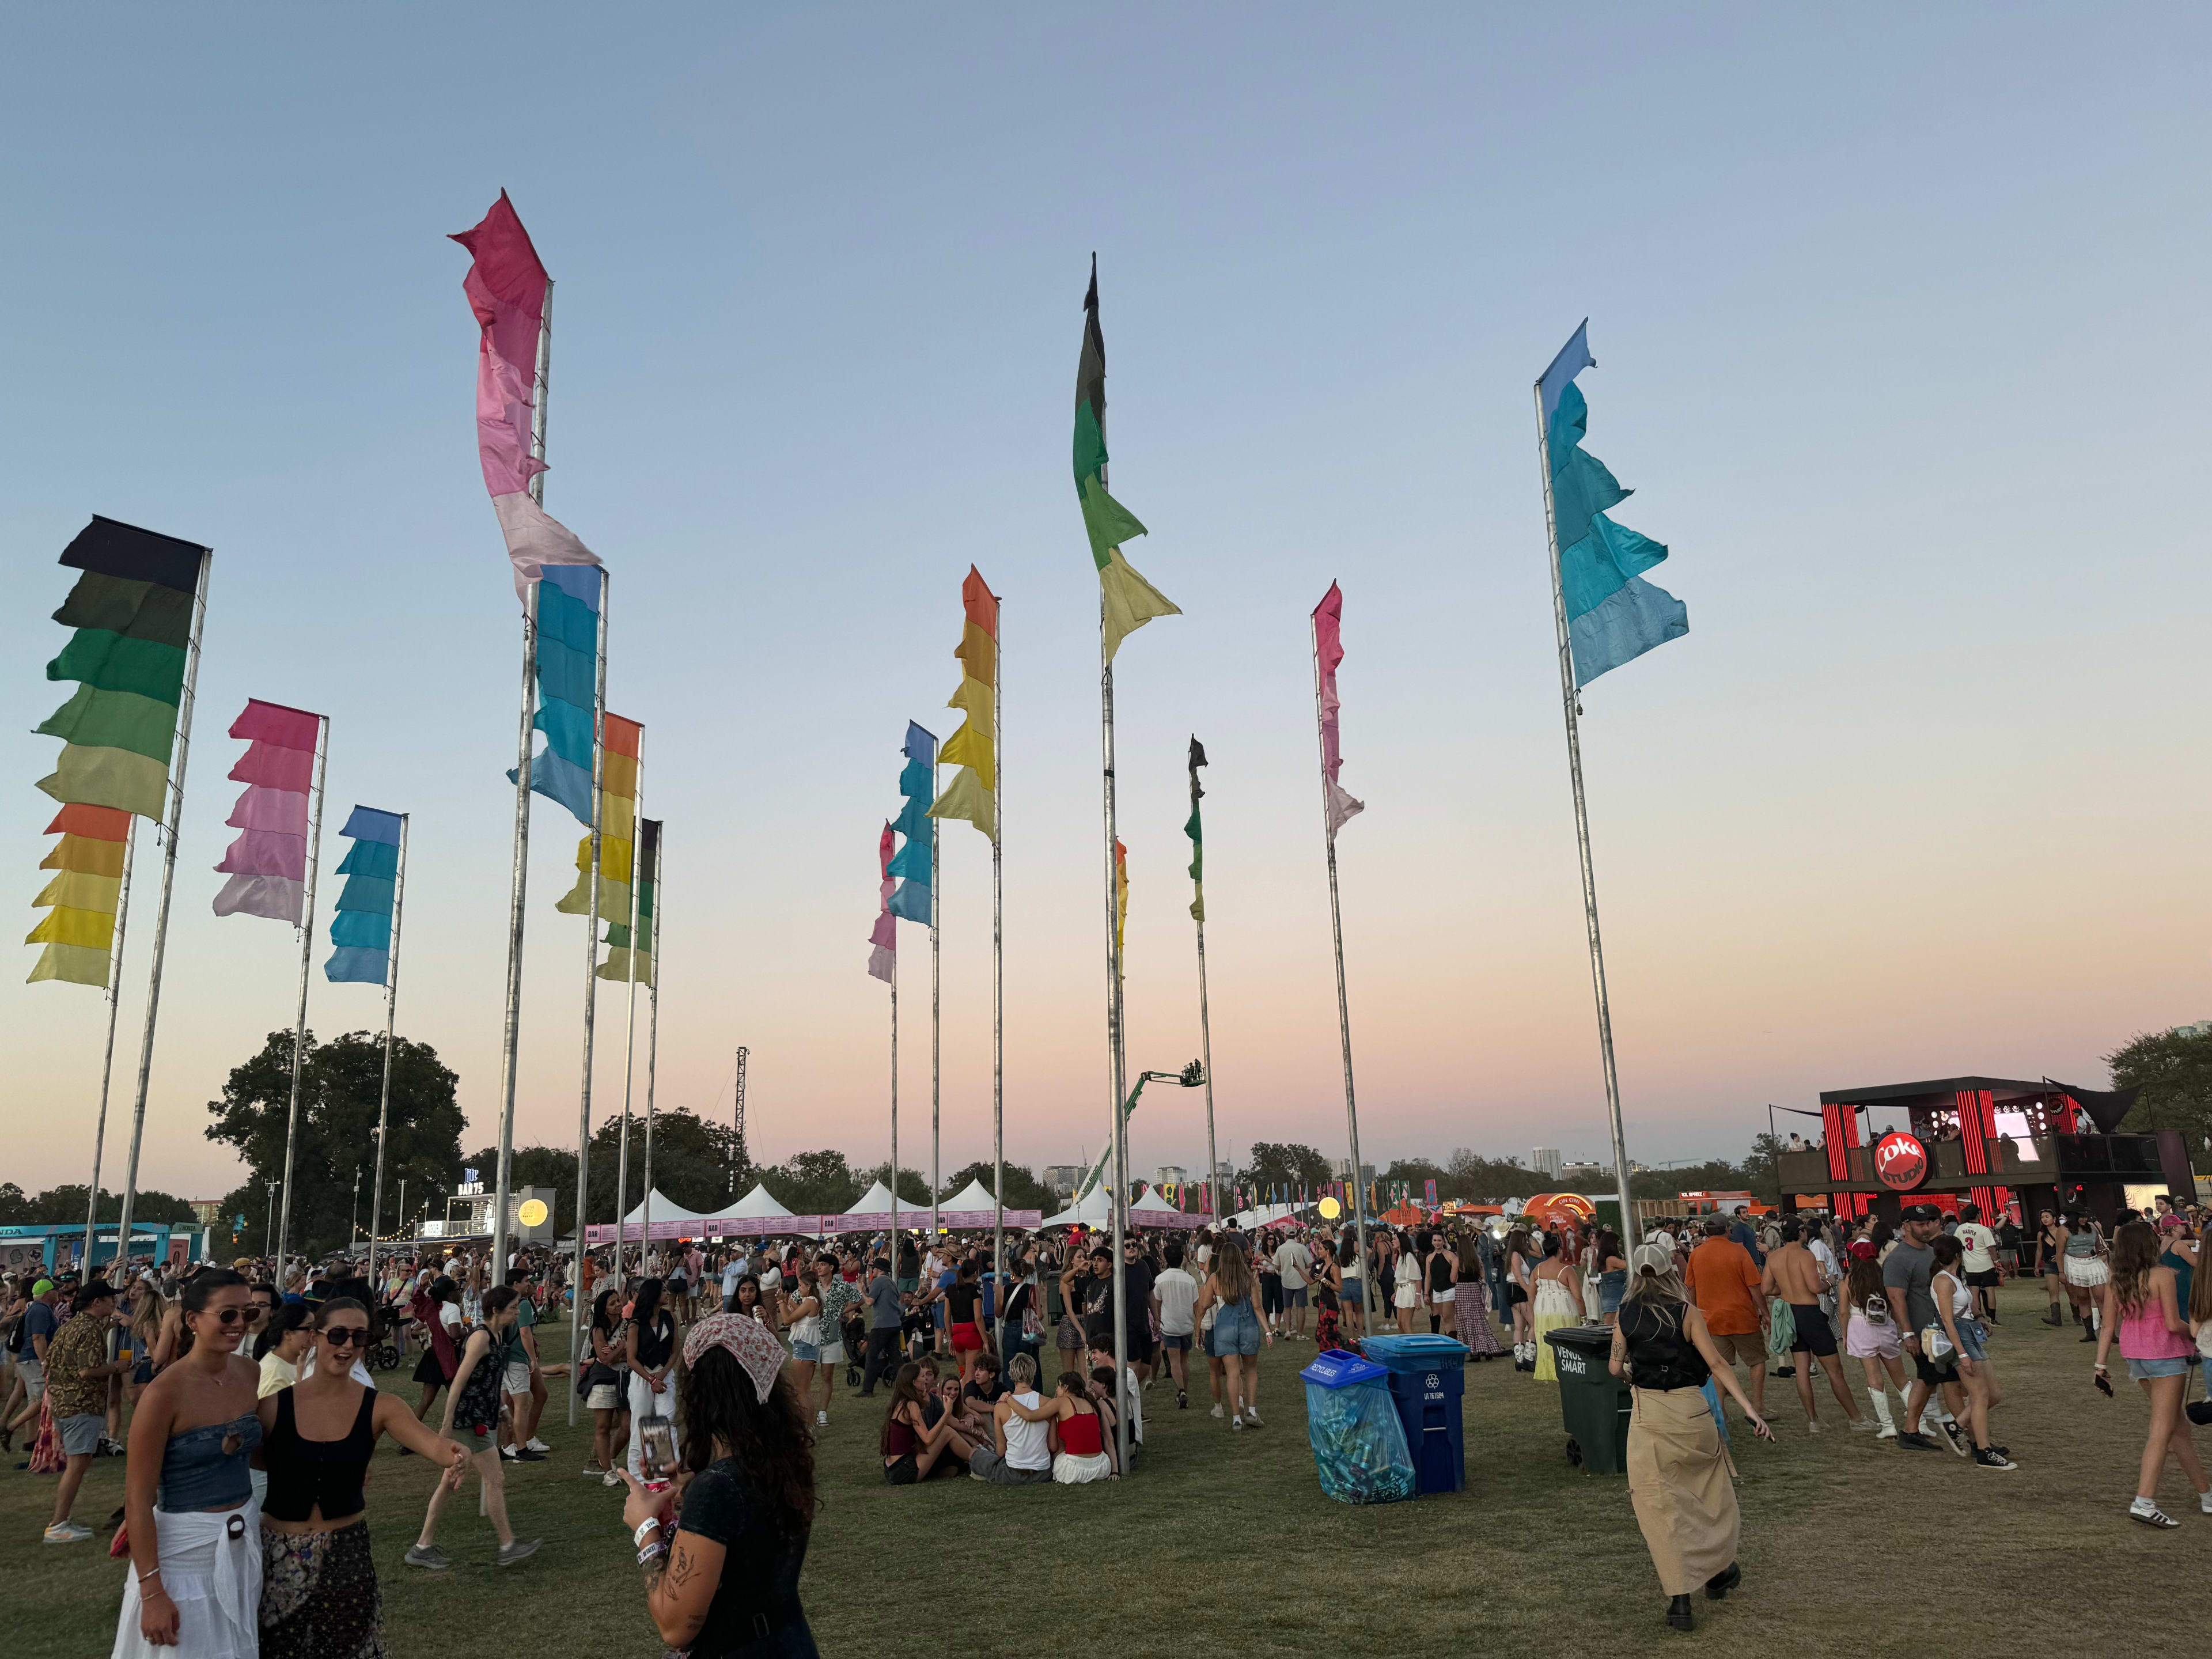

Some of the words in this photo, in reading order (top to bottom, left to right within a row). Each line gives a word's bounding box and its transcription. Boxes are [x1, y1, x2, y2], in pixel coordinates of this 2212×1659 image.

[1878, 1137, 1922, 1173] Coke
[464, 1168, 479, 1182] Lite
[1883, 1156, 1923, 1184] STUDIO
[458, 1184, 472, 1196] BAR
[474, 1182, 484, 1194] 75
[1965, 1237, 1974, 1251] 3
[1561, 1358, 1586, 1374] SMART
